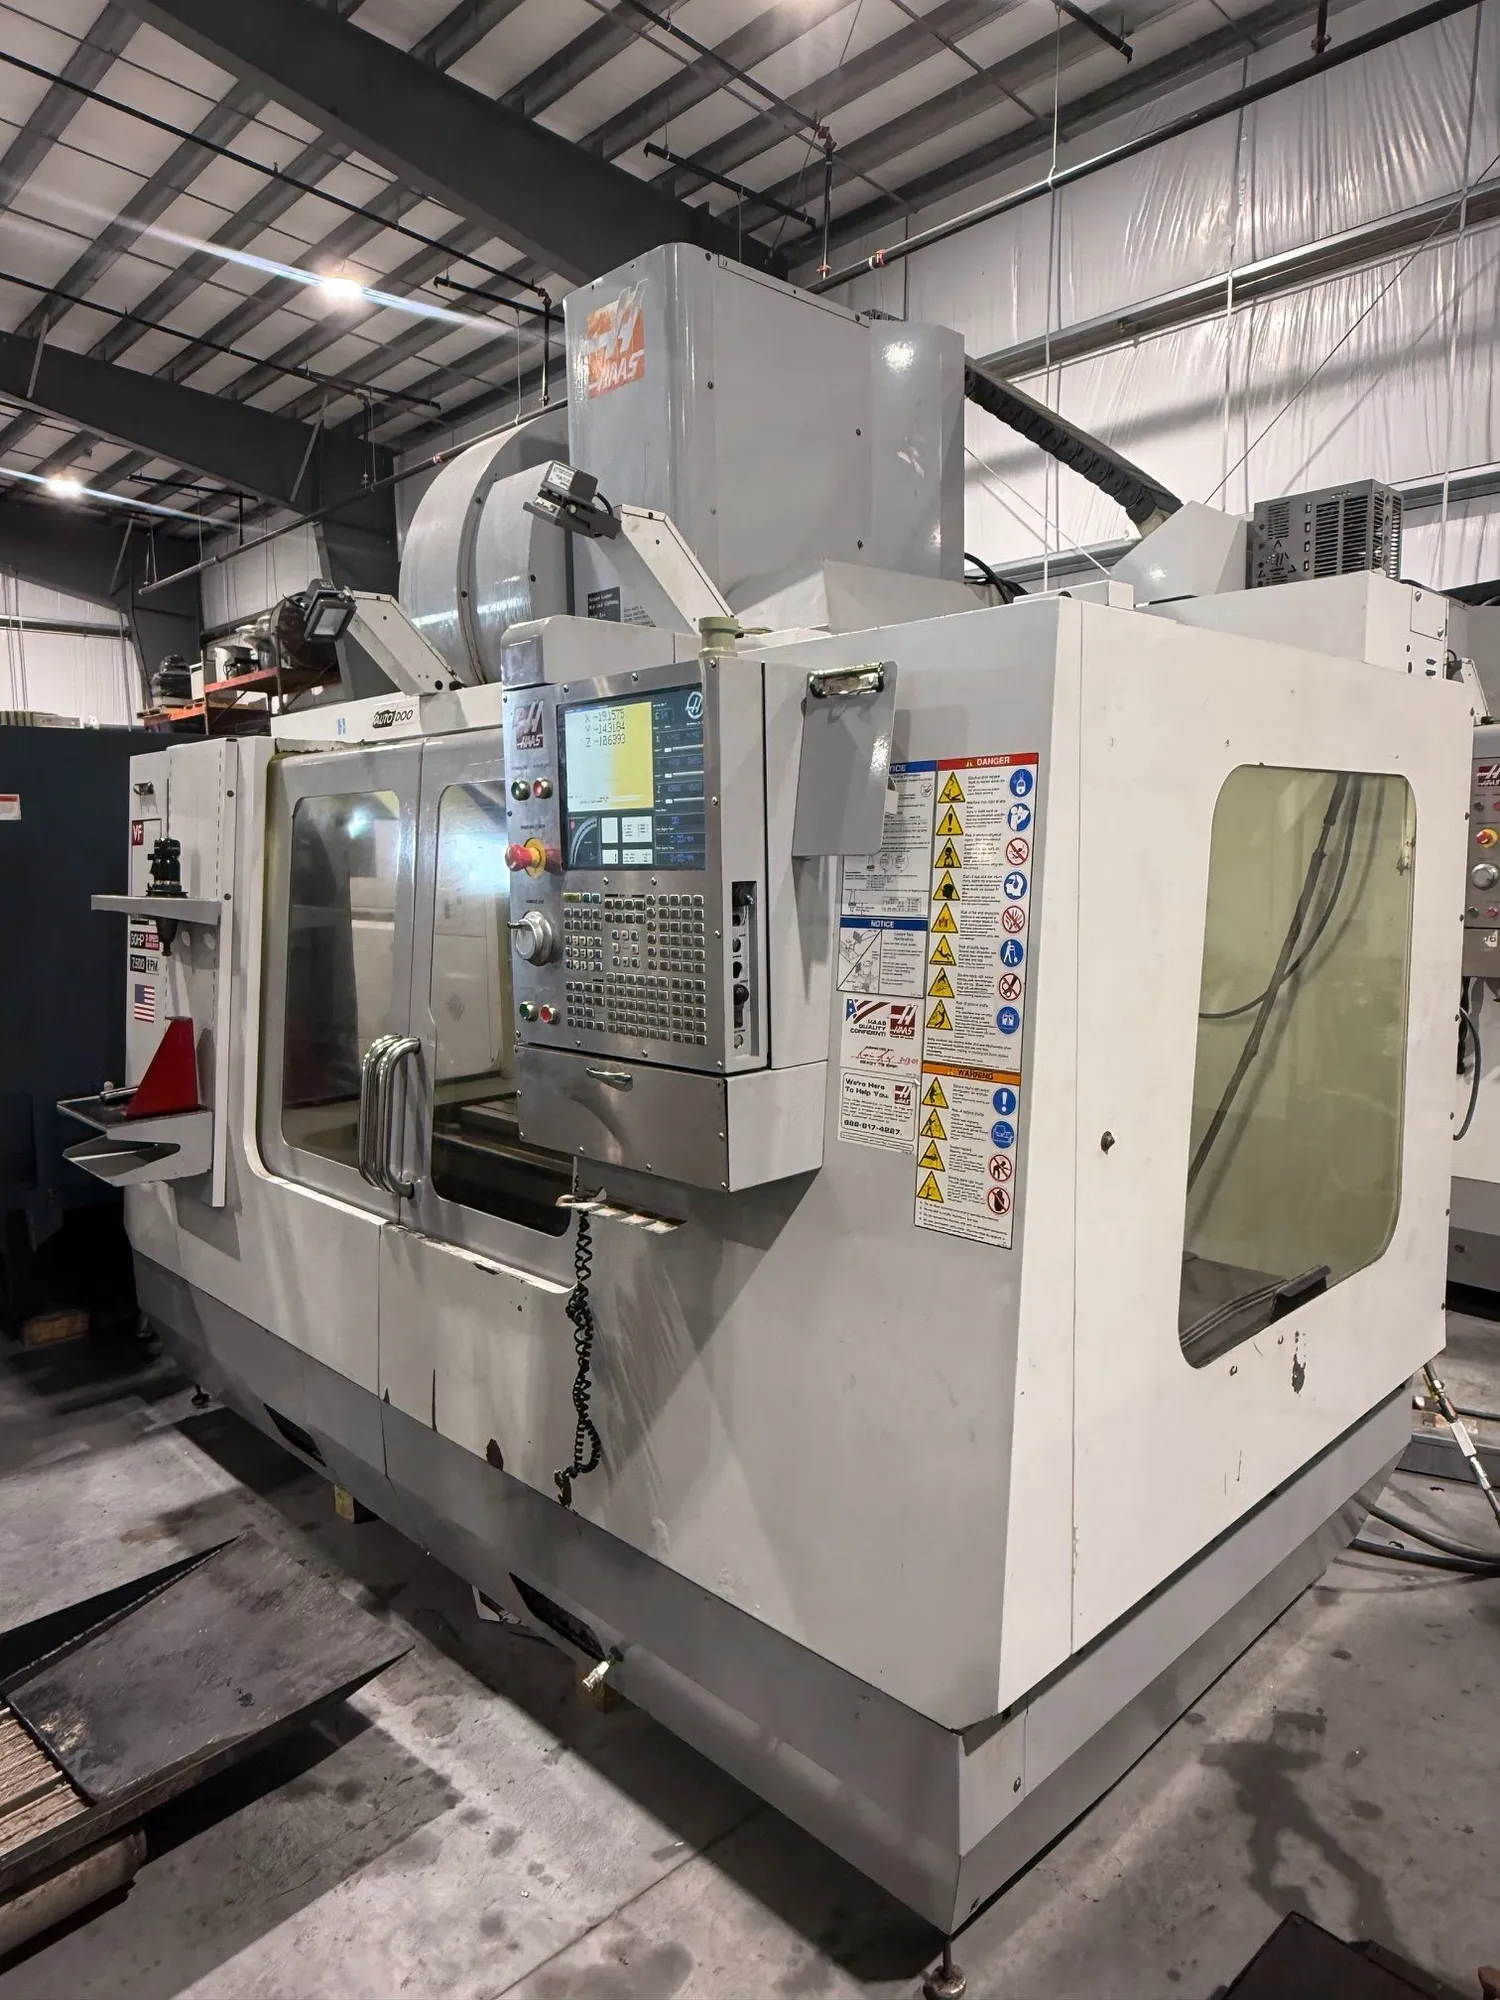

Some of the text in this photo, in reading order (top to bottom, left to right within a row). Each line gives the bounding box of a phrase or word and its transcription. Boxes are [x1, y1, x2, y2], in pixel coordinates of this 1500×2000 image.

[373, 712, 394, 727] AUTO
[516, 733, 543, 749] HAAS
[585, 737, 591, 748] Z
[976, 756, 1010, 767] DANGER
[889, 764, 906, 774] TICE
[133, 825, 143, 840] VF
[871, 919, 895, 929] NOTICE
[958, 1068, 994, 1080] WARNING
